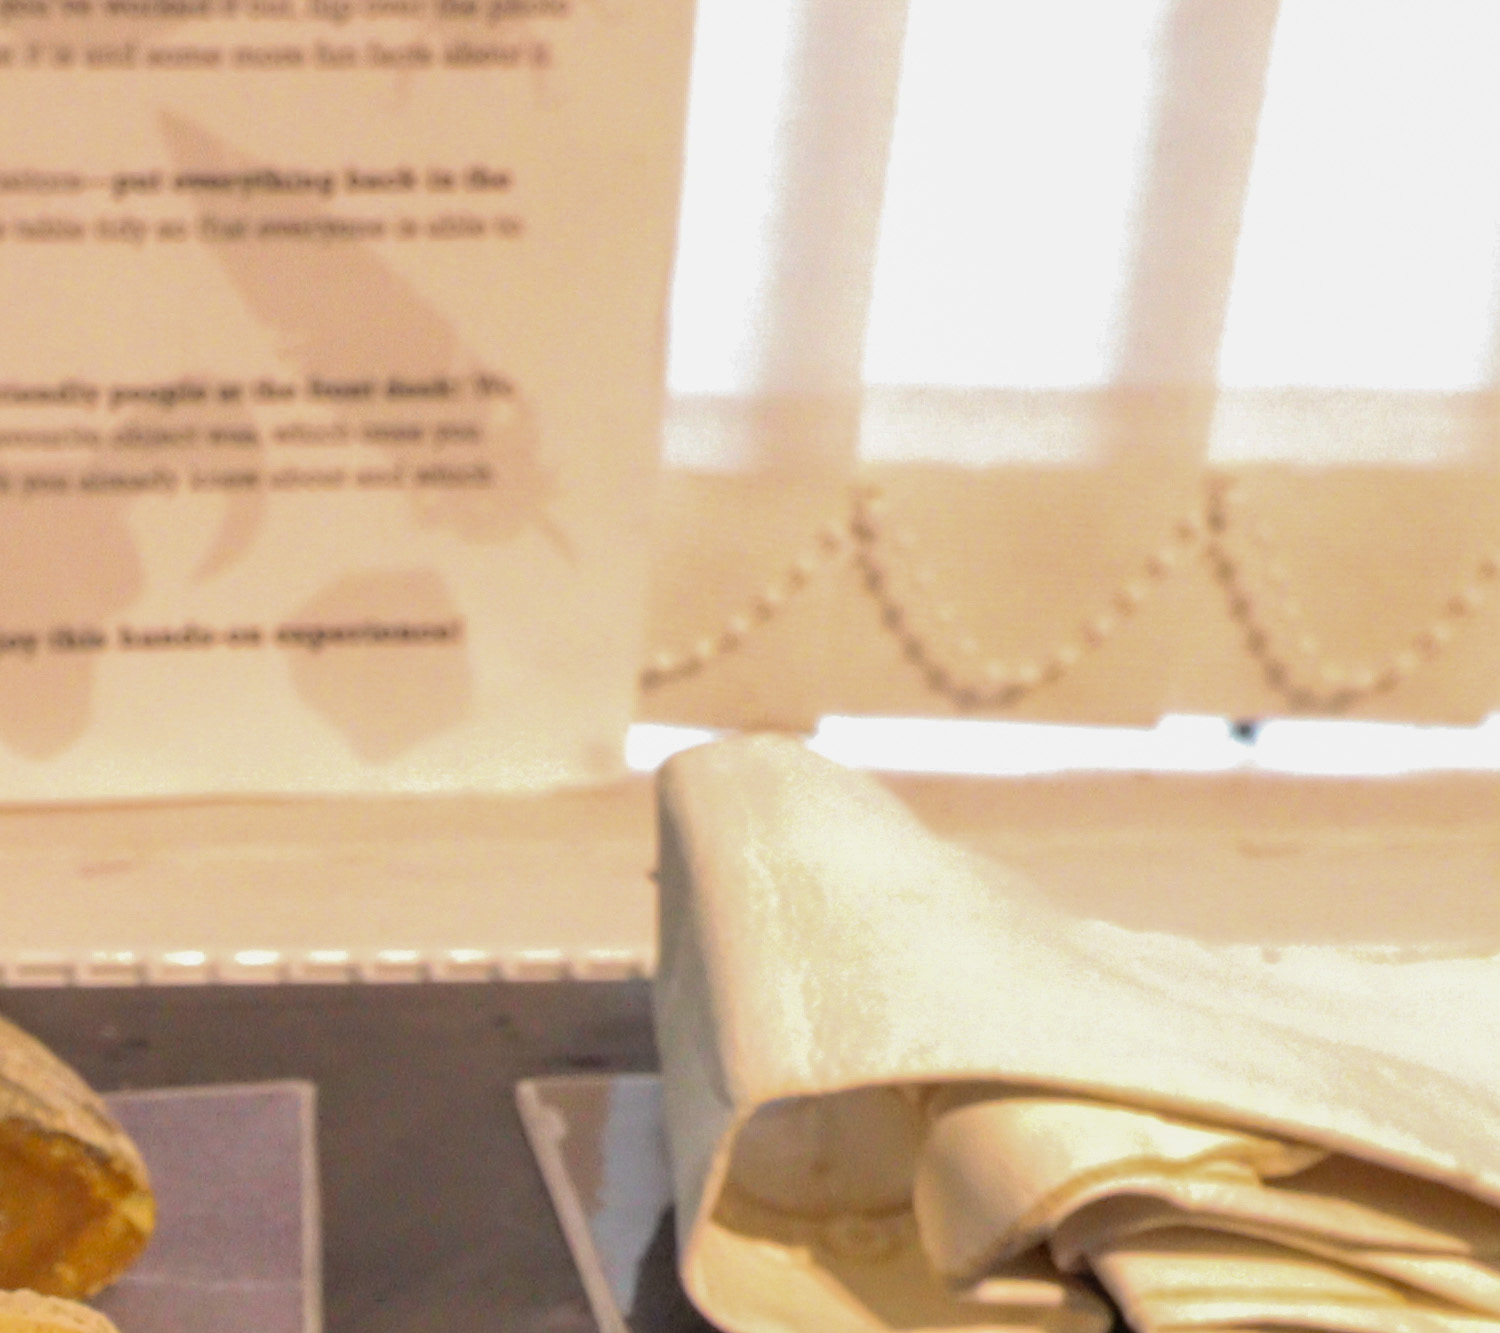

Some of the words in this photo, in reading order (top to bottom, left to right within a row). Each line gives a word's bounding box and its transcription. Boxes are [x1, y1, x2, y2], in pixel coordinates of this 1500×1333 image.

[46, 621, 110, 650] this
[116, 621, 264, 650] hands-on
[271, 620, 464, 655] experience!
